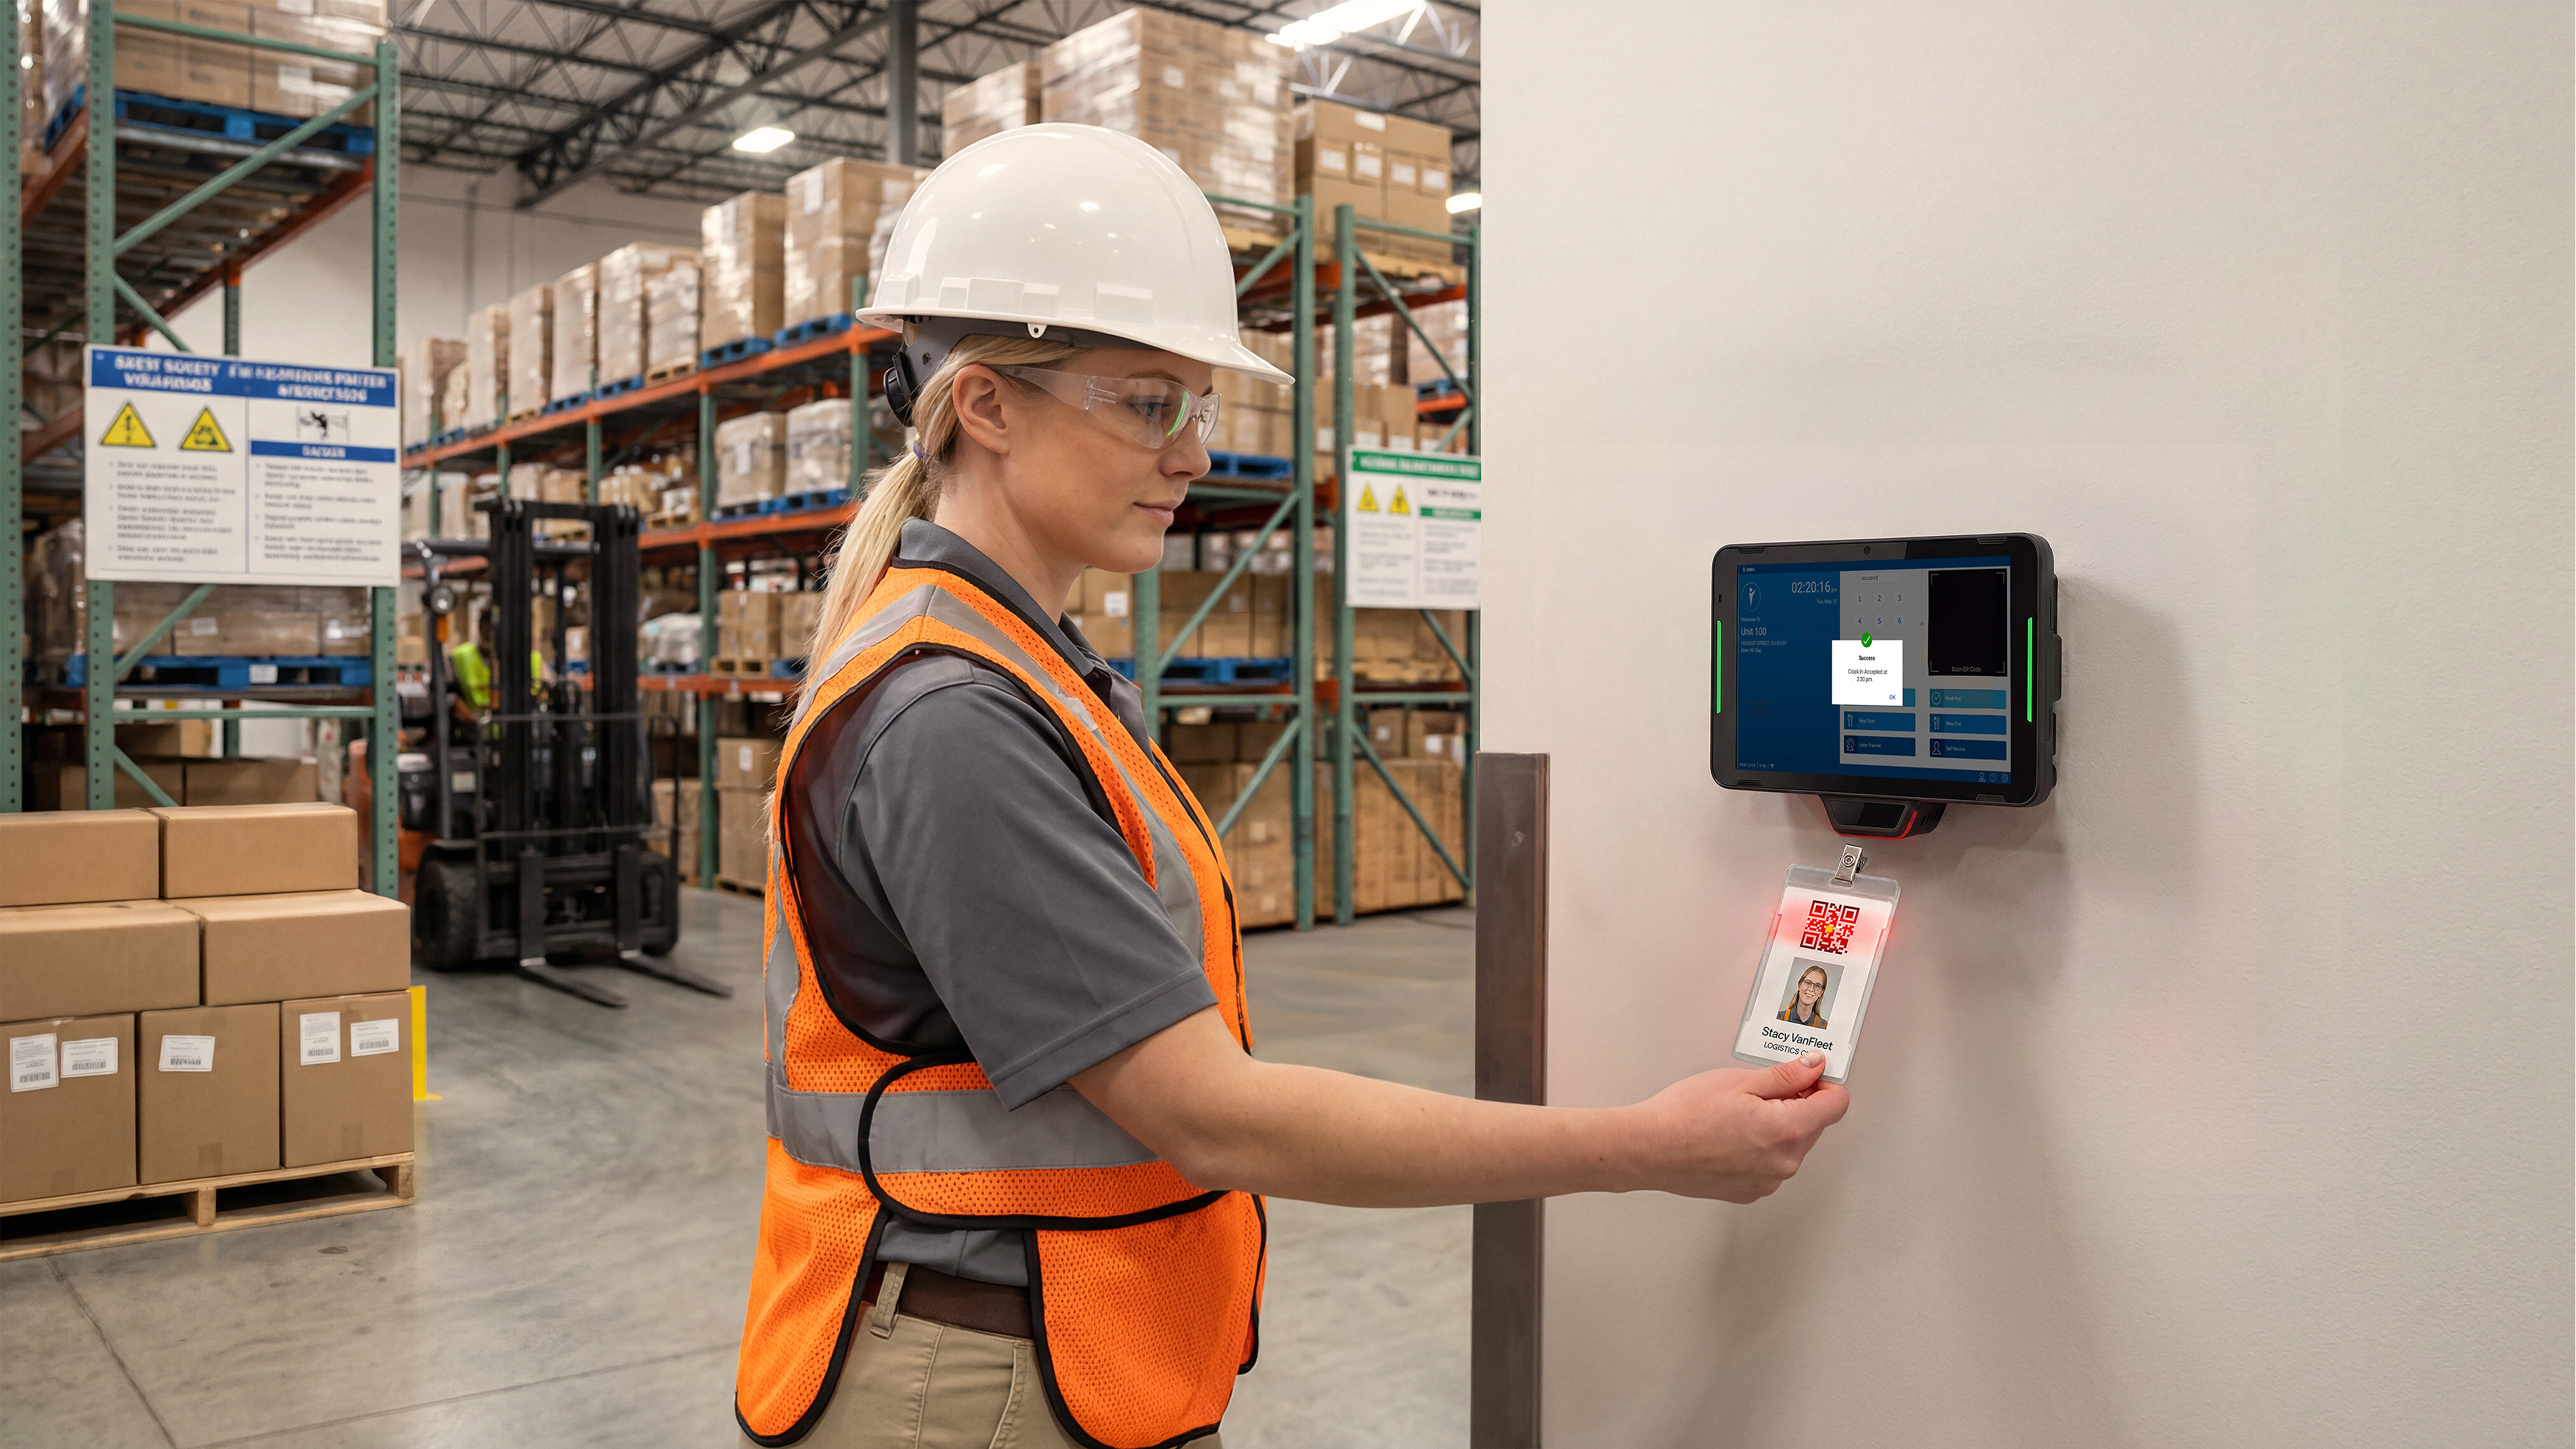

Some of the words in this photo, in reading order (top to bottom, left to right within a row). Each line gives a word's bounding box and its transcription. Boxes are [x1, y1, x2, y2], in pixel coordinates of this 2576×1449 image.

[1791, 581, 1830, 593] 02:20:16
[1762, 1026, 1790, 1043] Stacy
[1792, 1033, 1833, 1050] VanFleet
[1763, 1041, 1800, 1055] LOGISTICS
